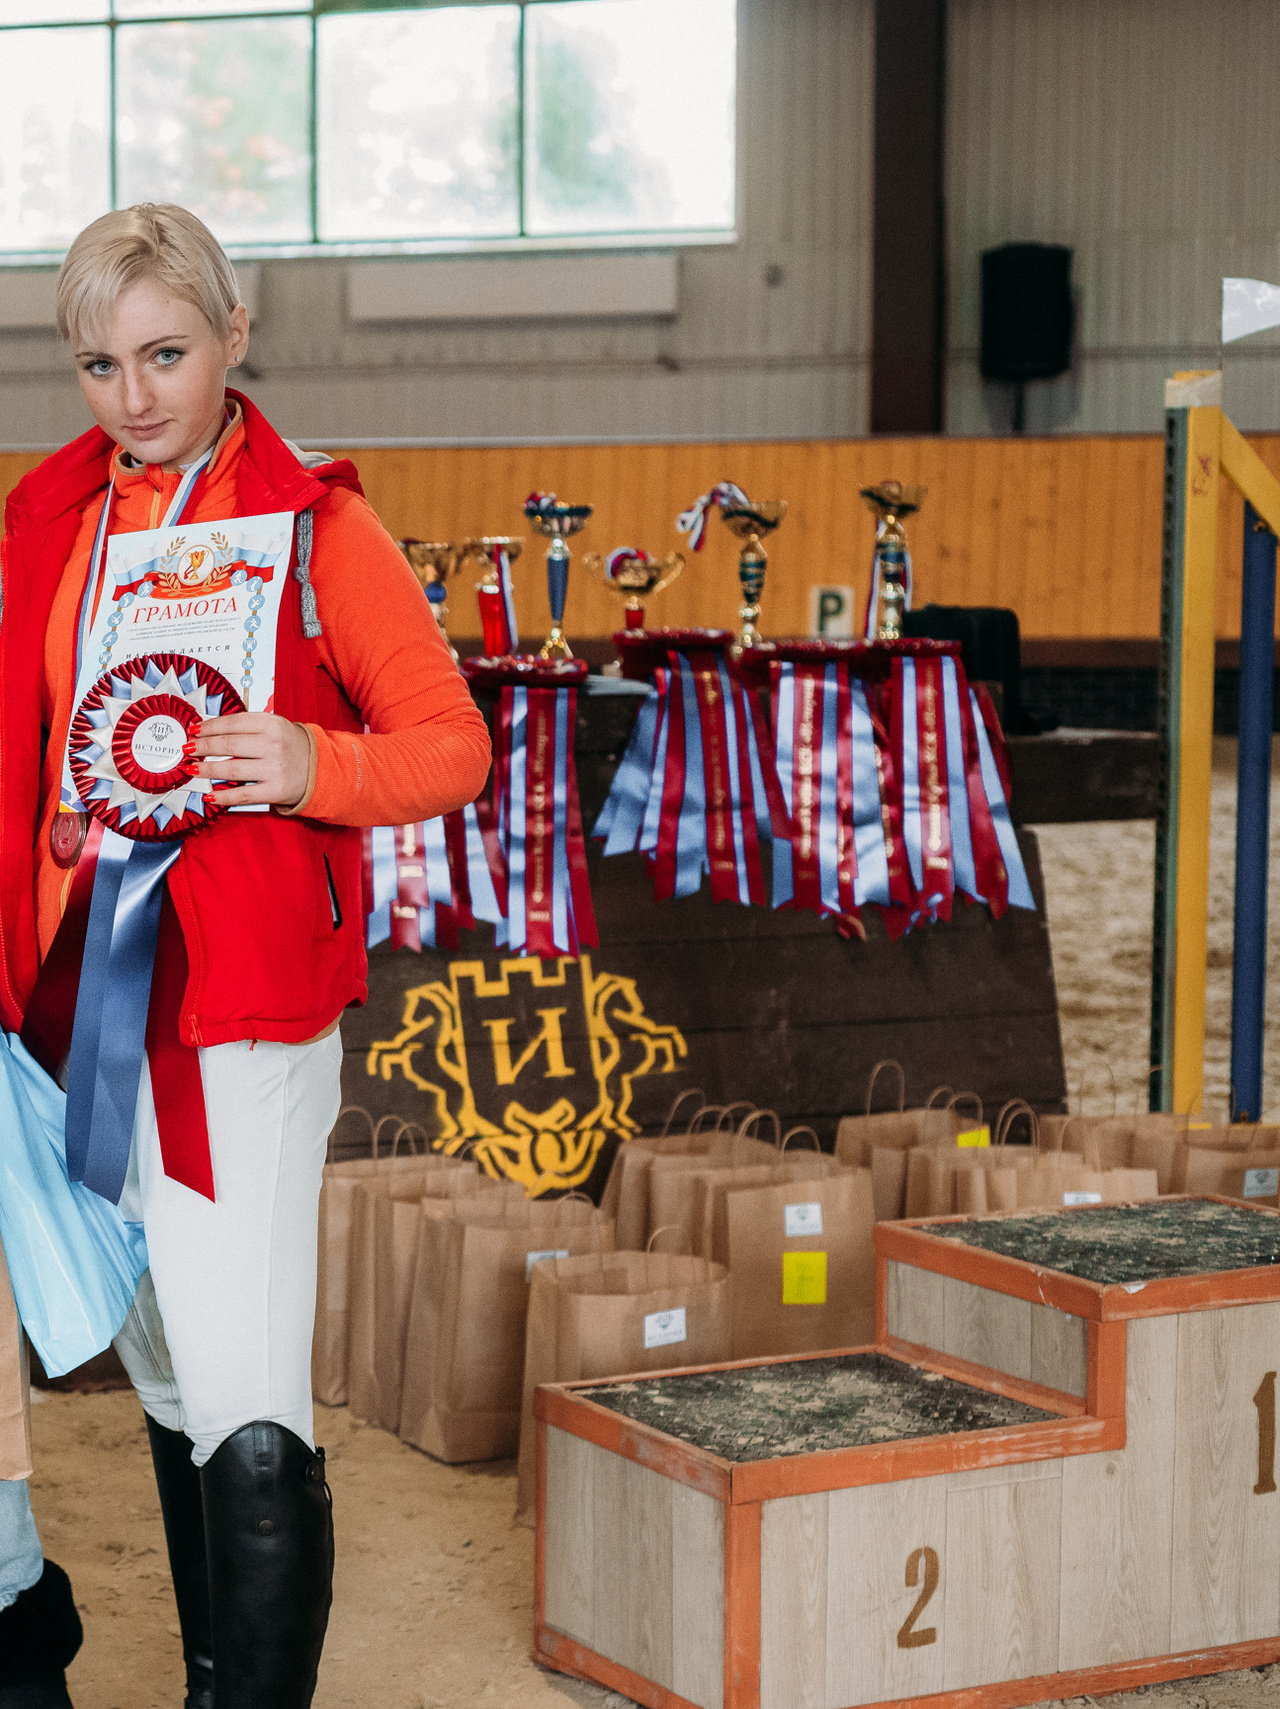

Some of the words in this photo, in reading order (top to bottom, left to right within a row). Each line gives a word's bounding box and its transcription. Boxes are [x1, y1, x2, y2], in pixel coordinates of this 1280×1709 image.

[133, 597, 238, 623] ГРАМОТА
[818, 591, 845, 633] P
[134, 743, 181, 755] ИСТОРИЯ
[482, 1007, 576, 1086] И
[1253, 1371, 1278, 1495] 1
[896, 1546, 940, 1649] 2
